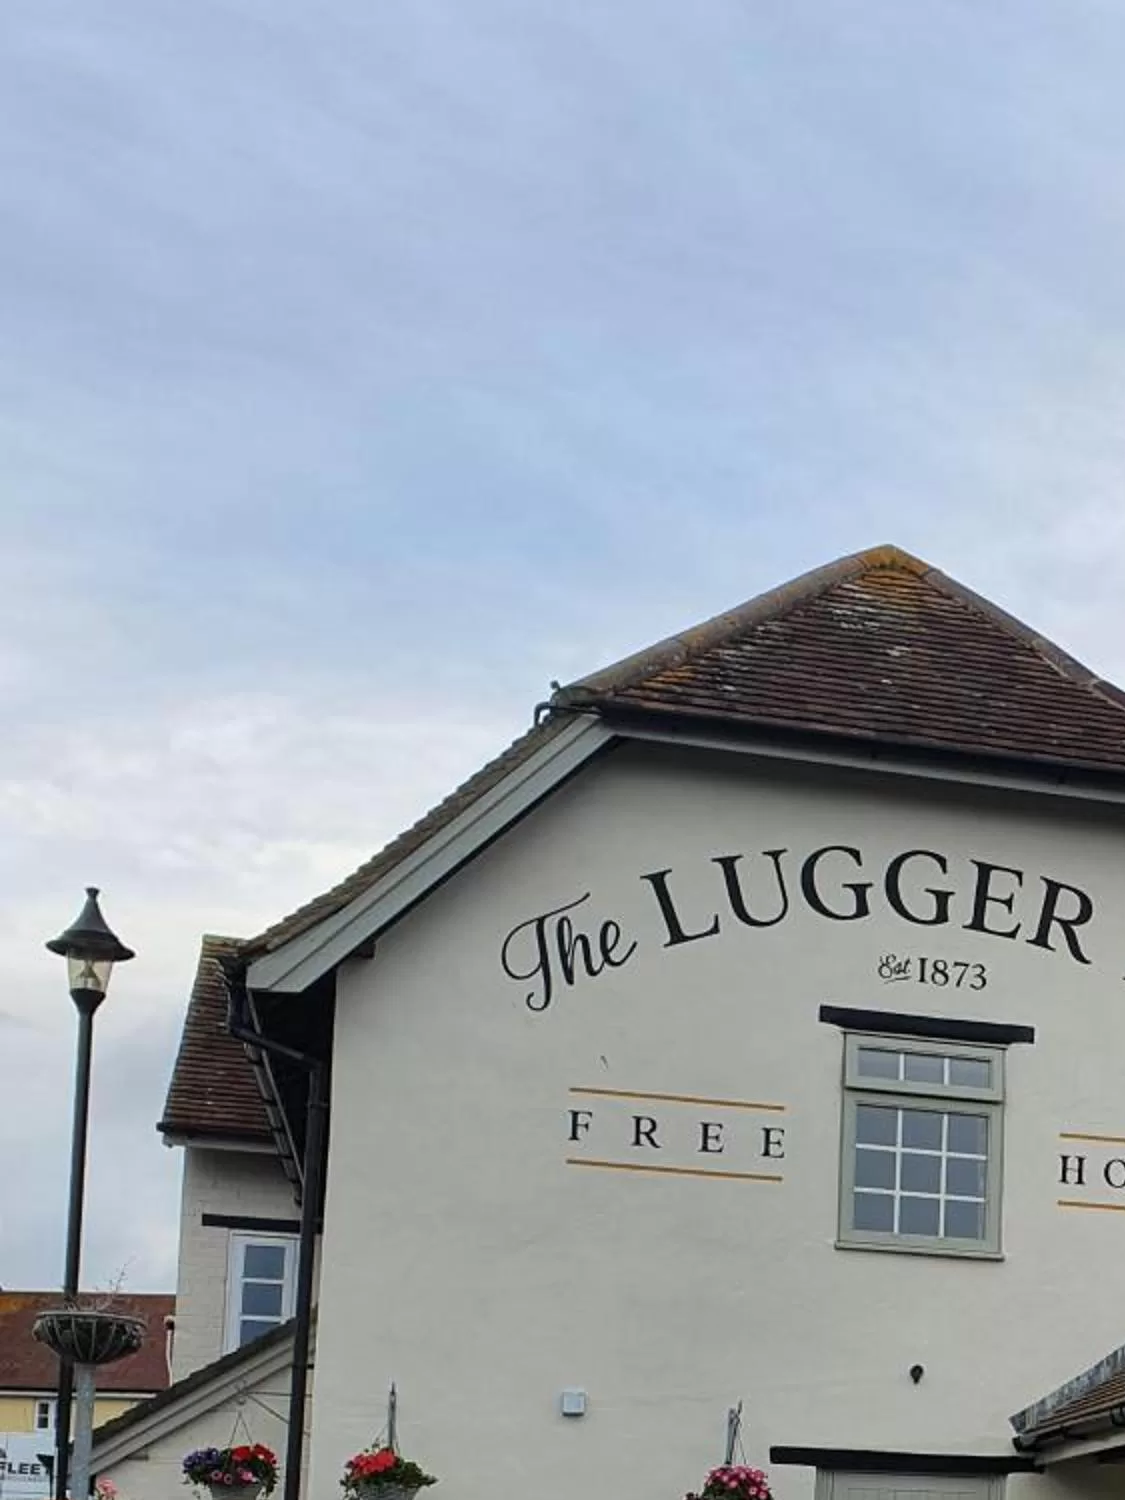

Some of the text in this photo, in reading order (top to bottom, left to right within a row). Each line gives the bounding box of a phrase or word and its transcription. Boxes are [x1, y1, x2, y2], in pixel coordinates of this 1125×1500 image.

[502, 893, 637, 1011] The
[640, 845, 1093, 965] LUGGER
[917, 957, 987, 991] 1873
[567, 1109, 786, 1160] FREE
